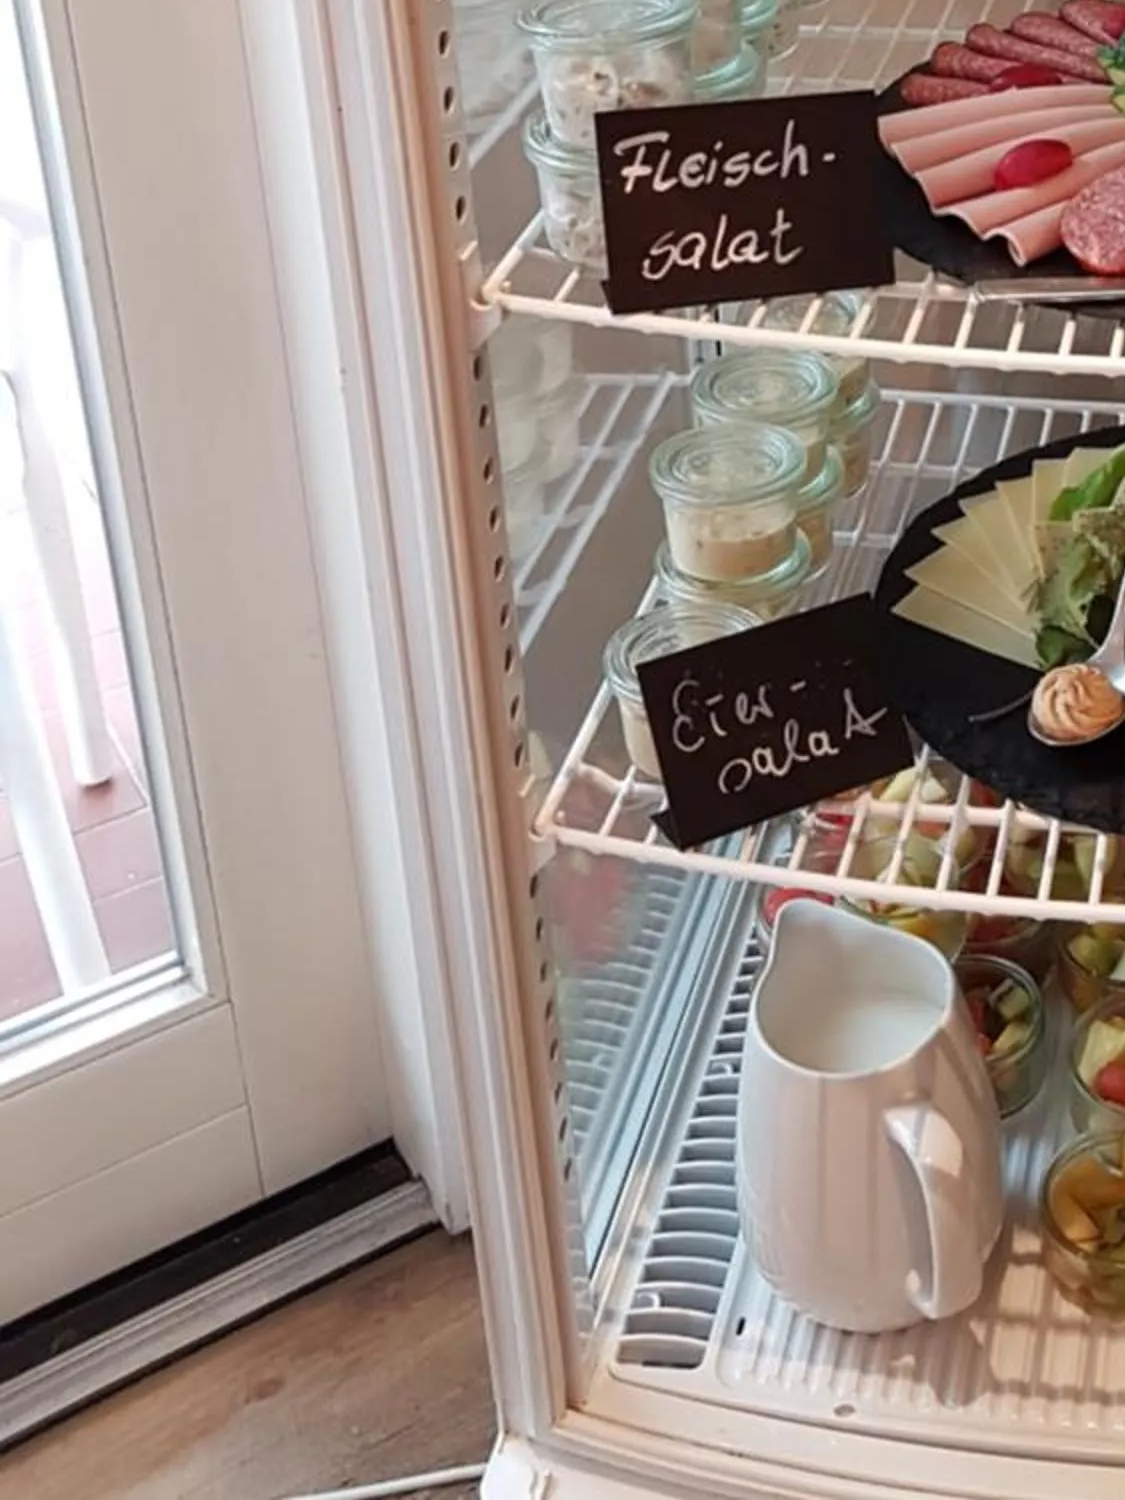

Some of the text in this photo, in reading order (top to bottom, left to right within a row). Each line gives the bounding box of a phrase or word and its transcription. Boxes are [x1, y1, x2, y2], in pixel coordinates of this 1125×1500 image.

[613, 118, 836, 195] Fleisch-
[641, 208, 804, 280] salat
[671, 678, 807, 753] Eier-
